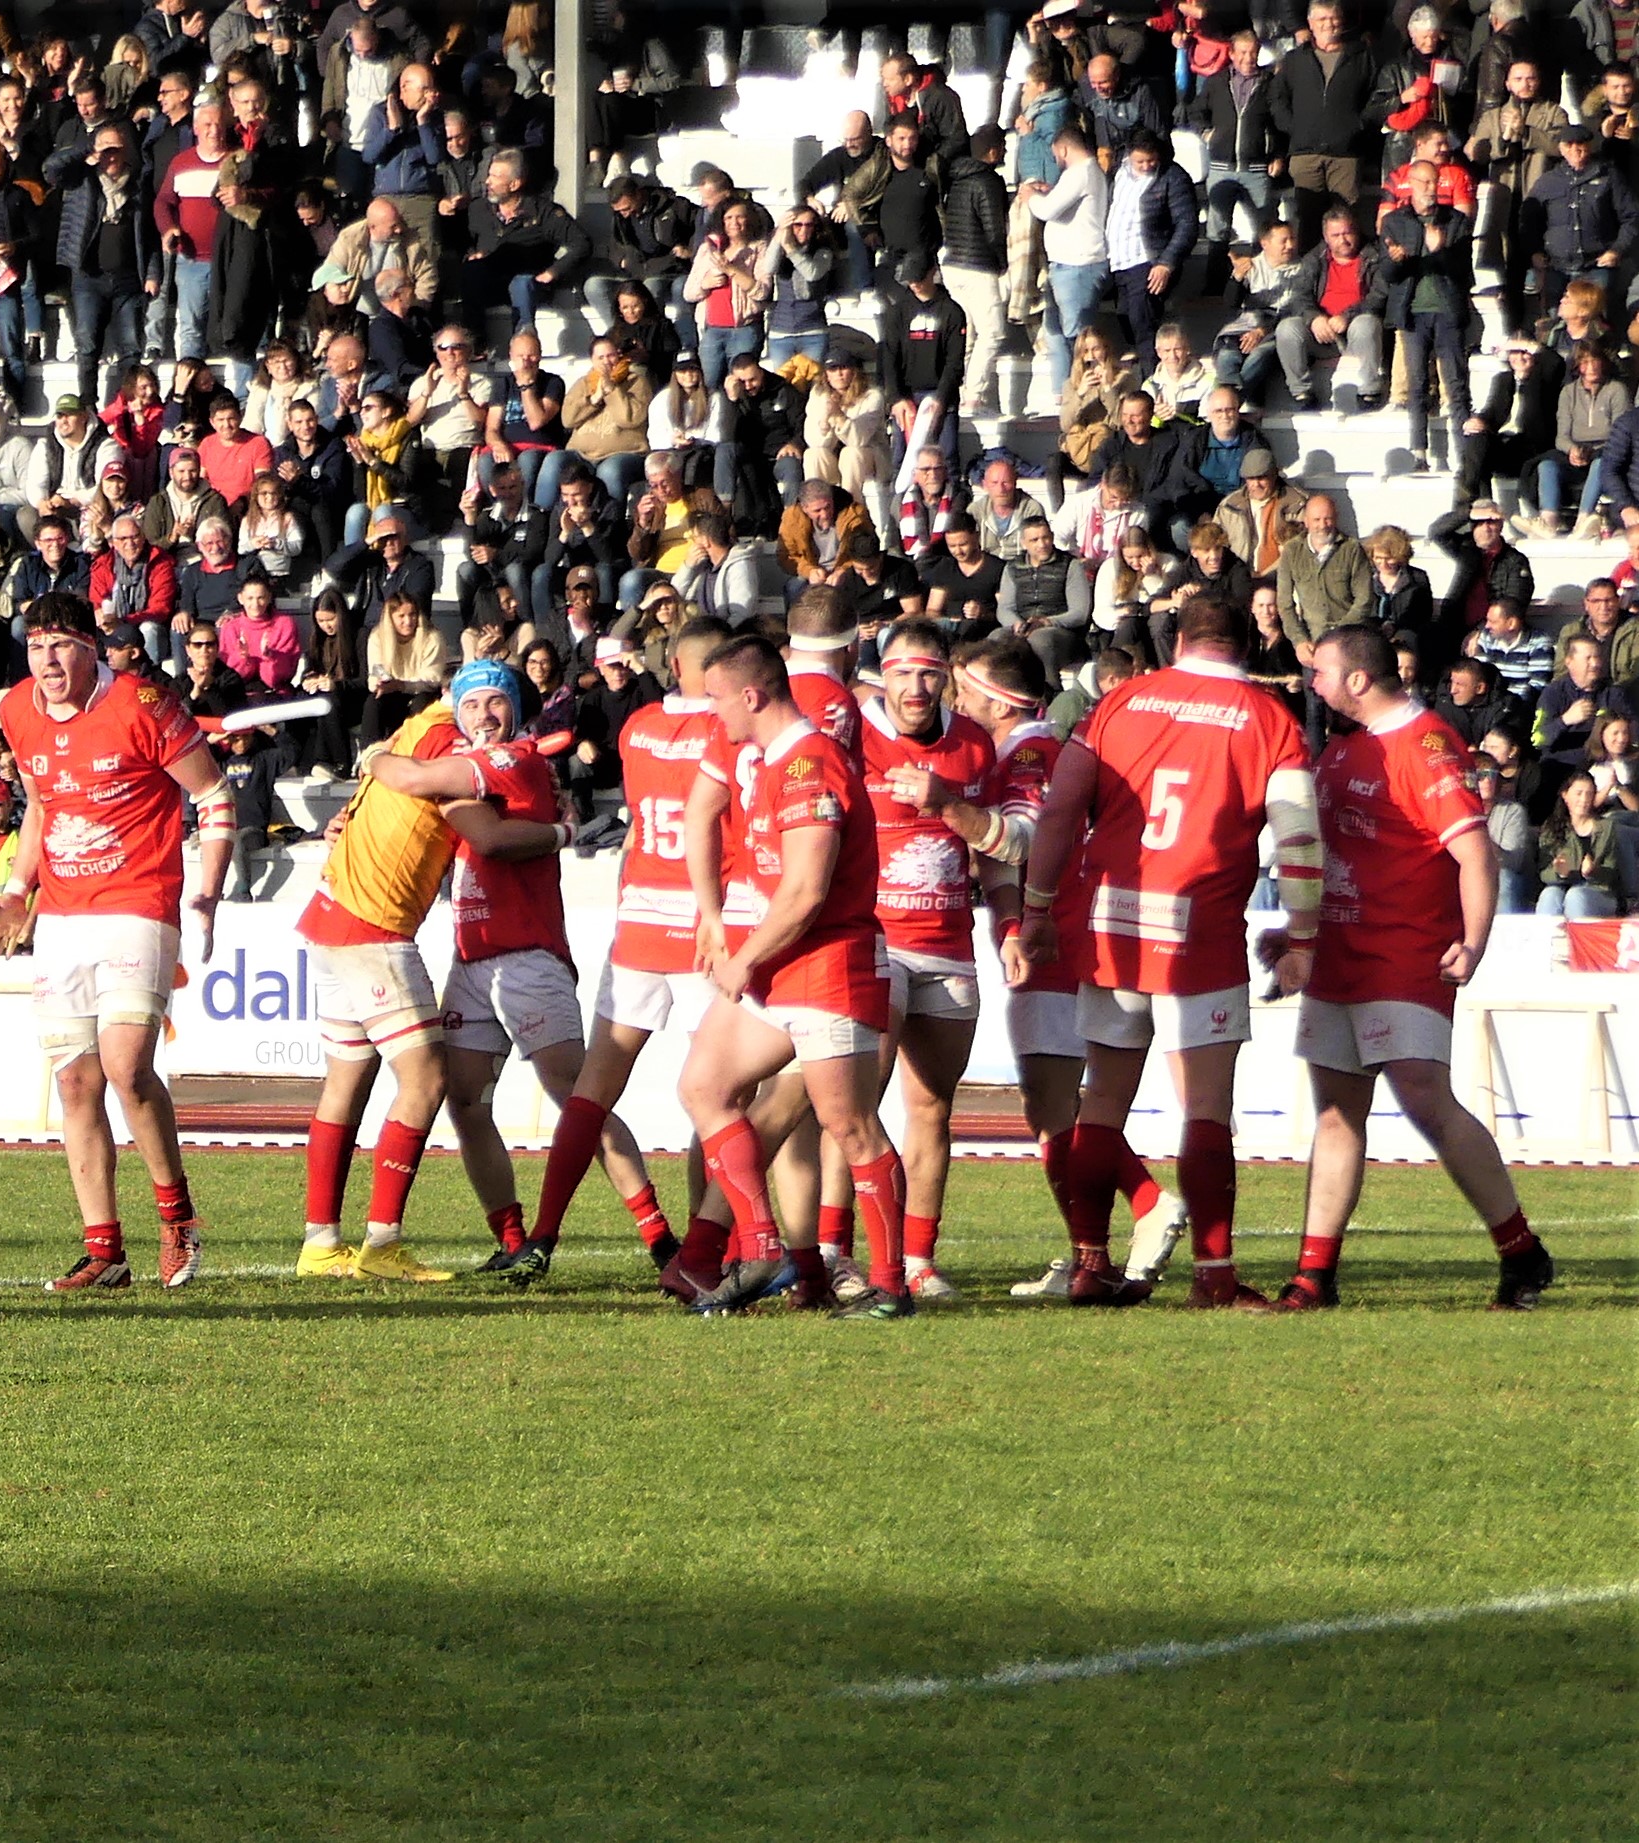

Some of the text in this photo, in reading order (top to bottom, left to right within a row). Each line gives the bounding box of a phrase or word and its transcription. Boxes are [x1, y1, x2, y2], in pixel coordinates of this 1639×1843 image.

[639, 797, 685, 860] 15
[1141, 769, 1189, 850] 5
[876, 894, 932, 911] GRAND
[202, 949, 318, 1022] dal
[255, 1041, 321, 1065] GROU
